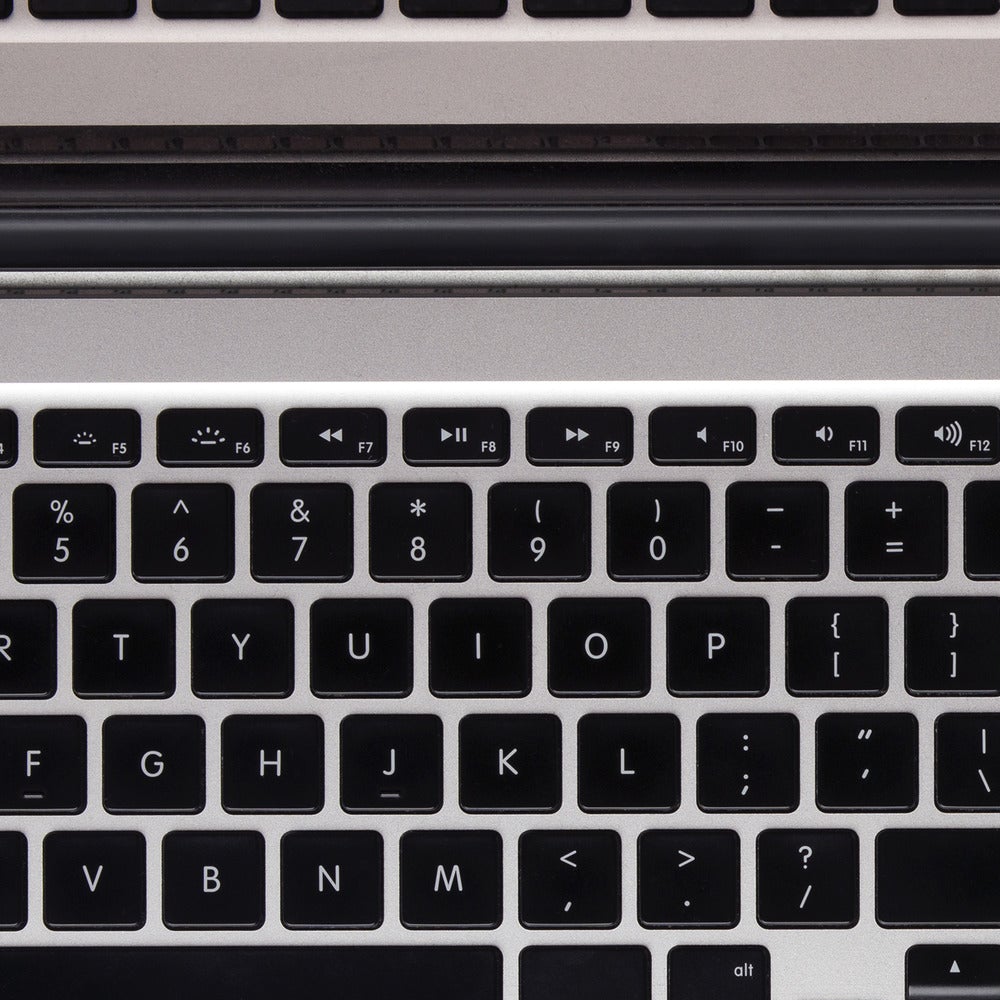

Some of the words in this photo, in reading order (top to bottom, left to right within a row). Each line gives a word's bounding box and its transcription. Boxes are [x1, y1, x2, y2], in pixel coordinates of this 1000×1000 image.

[112, 442, 127, 455] F5
[235, 442, 251, 454] F6
[358, 441, 374, 454] F7
[481, 440, 497, 453] F8
[605, 440, 620, 453] F9
[723, 440, 745, 453] F10
[849, 439, 867, 452] F11
[969, 439, 991, 452] F12
[50, 499, 74, 524] %
[290, 498, 310, 523] &
[535, 499, 541, 524] (
[654, 498, 661, 523] )
[885, 501, 903, 519] +
[53, 537, 70, 563] 5
[173, 536, 190, 562] 6
[291, 536, 308, 562] 7
[410, 536, 427, 562] 8
[529, 536, 546, 562] 9
[649, 535, 667, 561] 0
[885, 541, 904, 553] =
[830, 612, 841, 639] {
[949, 612, 960, 639] }
[0, 634, 12, 661] R
[112, 633, 130, 661] T
[231, 633, 251, 661] Y
[348, 632, 370, 660] U
[584, 632, 609, 660] O
[707, 632, 726, 660] P
[833, 651, 840, 678] [
[950, 651, 957, 678] ]
[26, 750, 42, 777] F
[140, 750, 165, 778] G
[259, 749, 282, 777] H
[382, 748, 396, 776] J
[498, 748, 519, 776] K
[620, 747, 636, 775] L
[741, 773, 749, 796] ;
[977, 768, 991, 793] \
[559, 850, 577, 868] <
[677, 849, 696, 868] >
[798, 845, 813, 869] ?
[82, 864, 104, 893] V
[203, 865, 221, 893] B
[318, 864, 340, 892] N
[433, 864, 464, 892] M
[799, 884, 813, 909] /
[733, 962, 754, 977] alt
